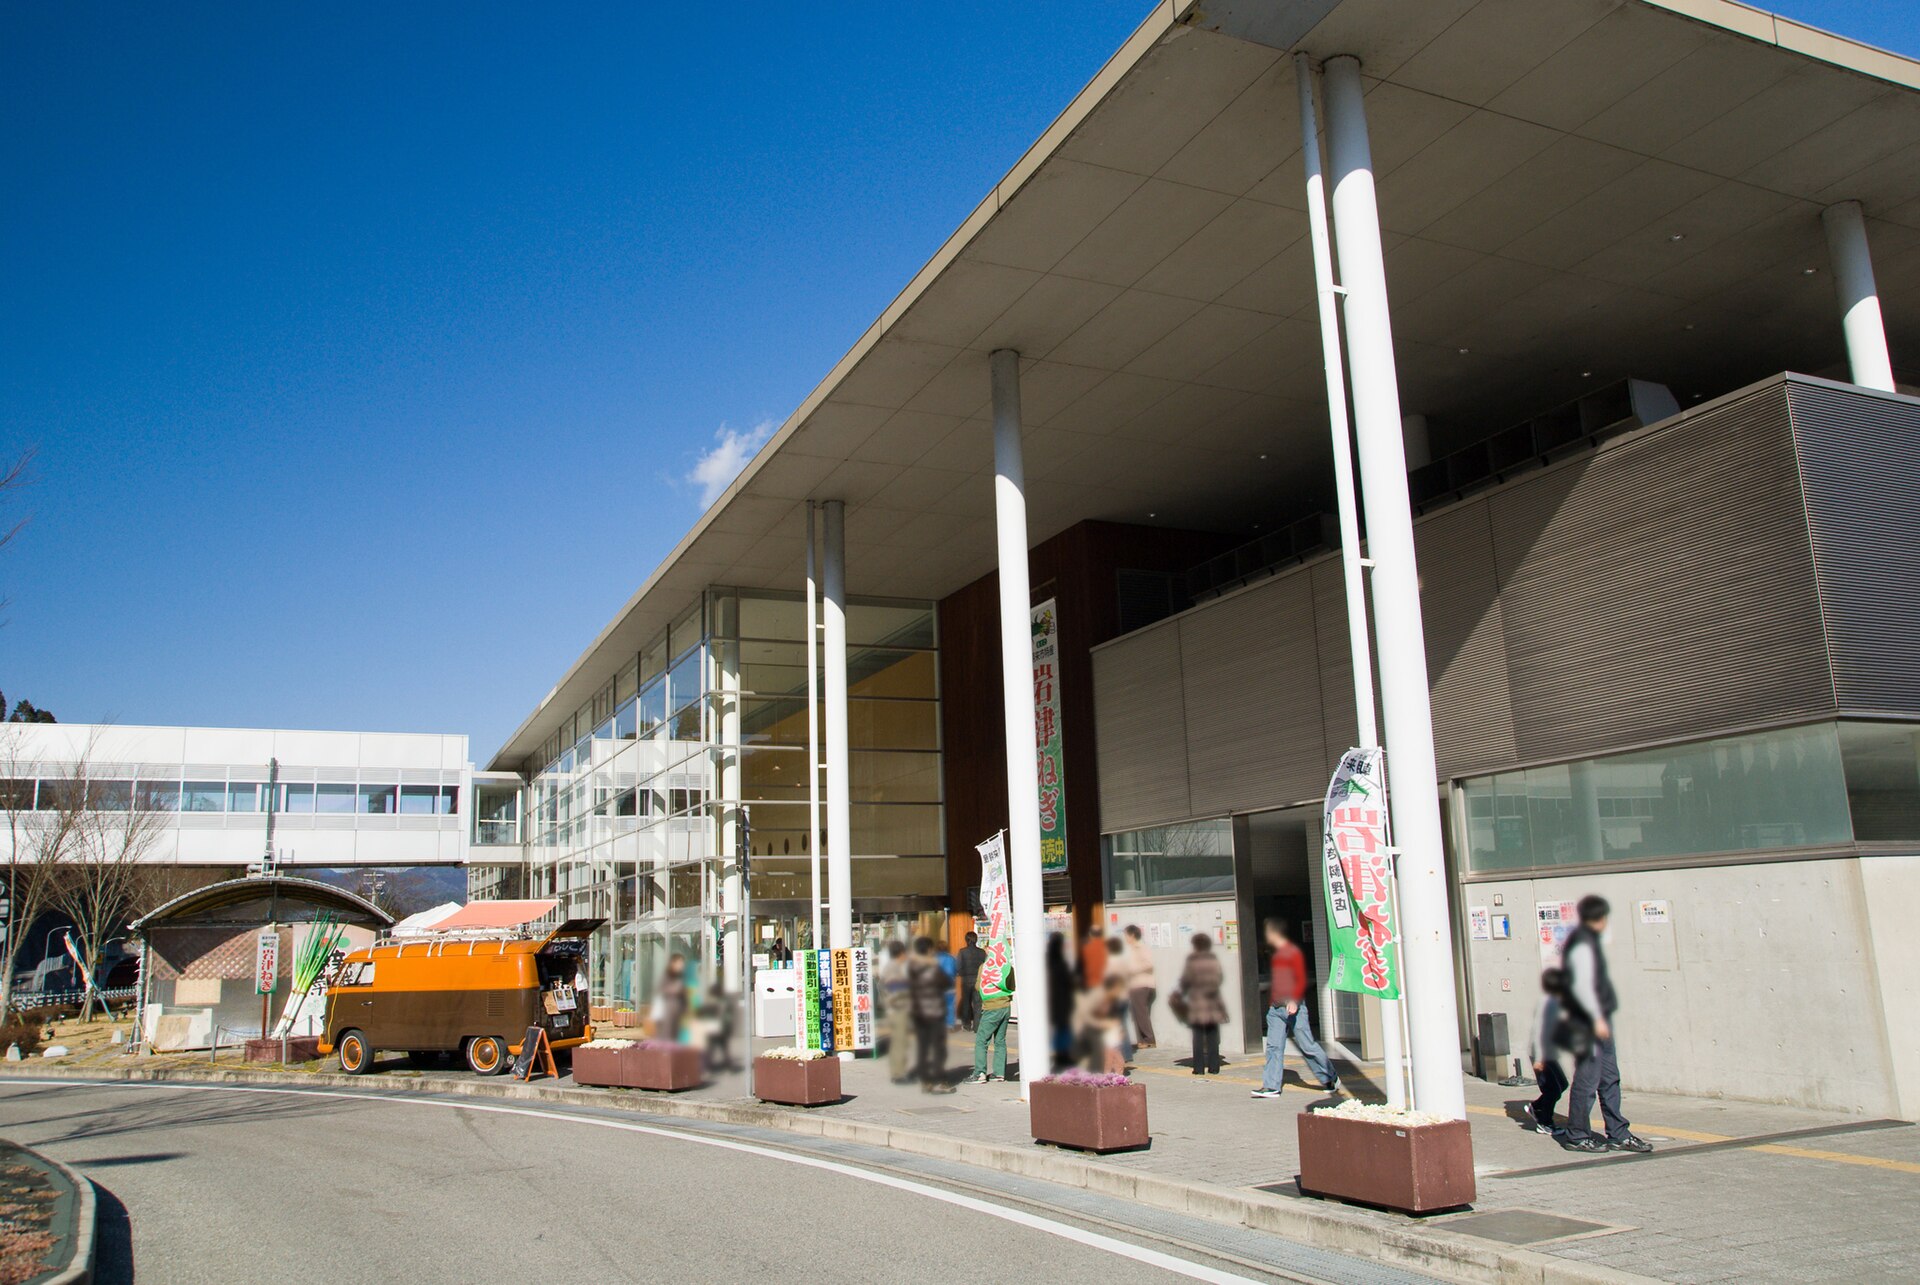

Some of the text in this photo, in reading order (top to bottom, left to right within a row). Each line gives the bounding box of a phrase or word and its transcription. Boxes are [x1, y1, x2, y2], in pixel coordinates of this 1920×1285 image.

[806, 952, 817, 987] 通勤割引
[835, 951, 848, 986] 休日割引
